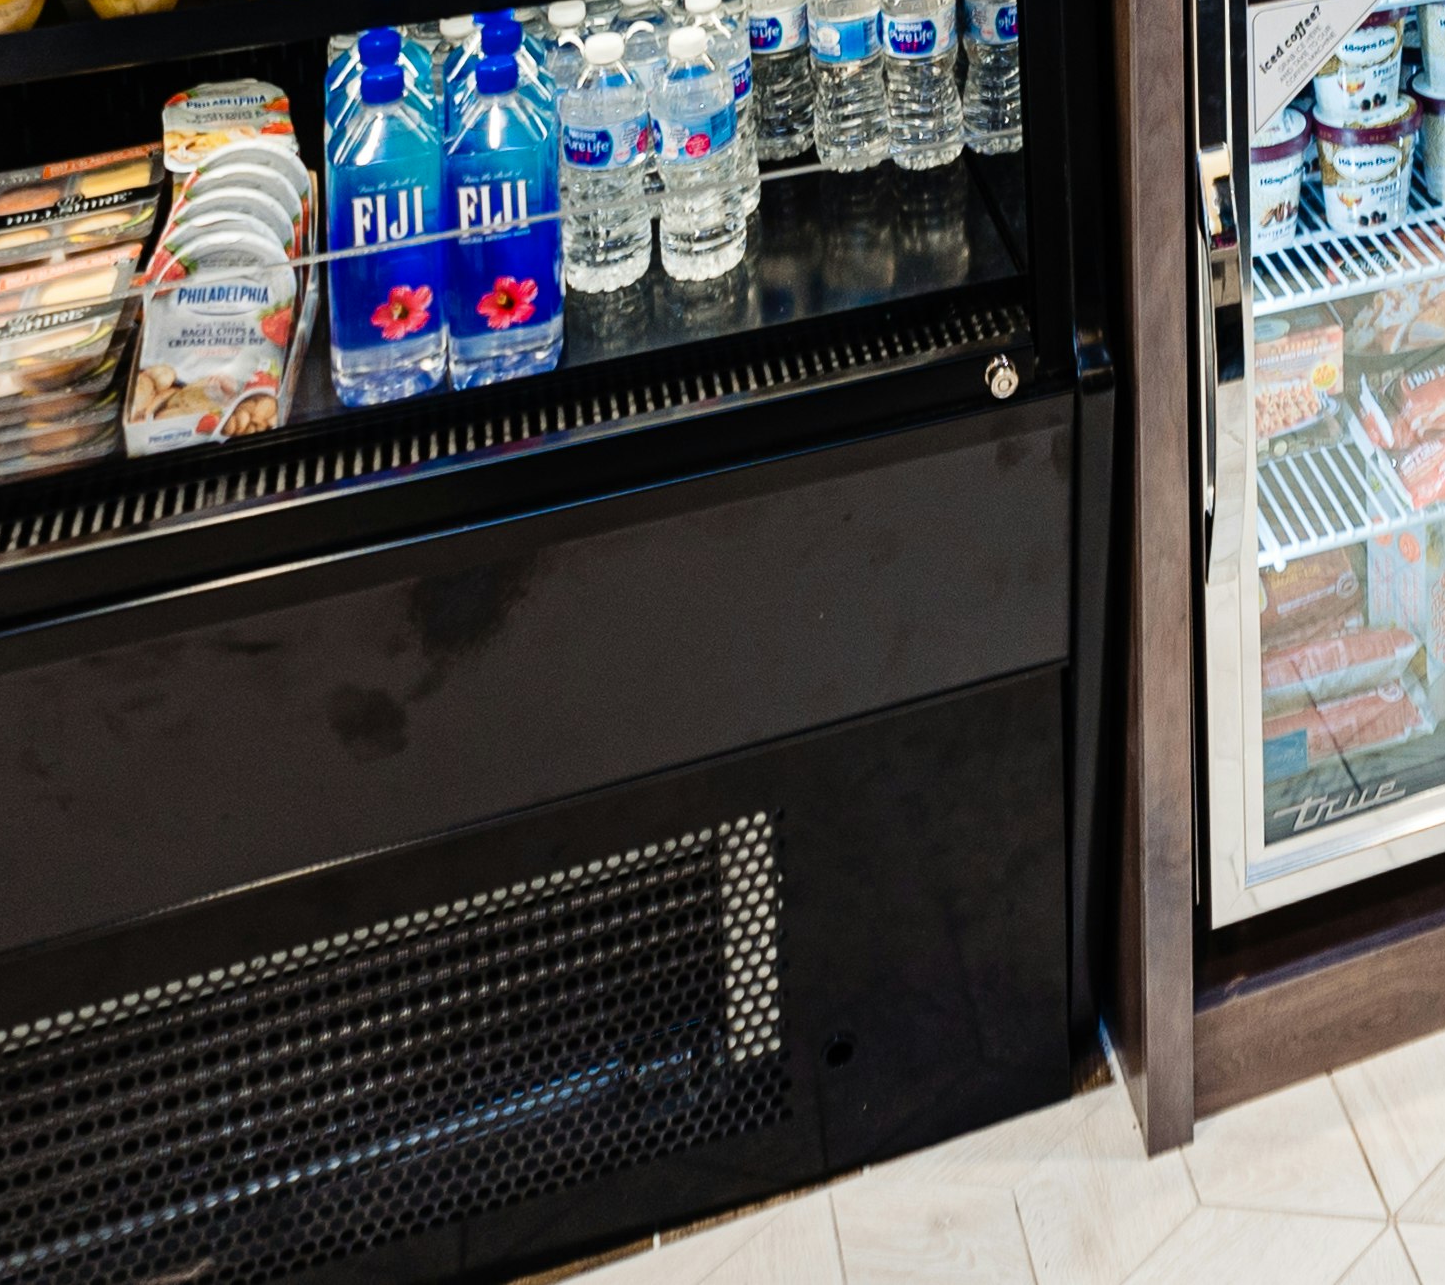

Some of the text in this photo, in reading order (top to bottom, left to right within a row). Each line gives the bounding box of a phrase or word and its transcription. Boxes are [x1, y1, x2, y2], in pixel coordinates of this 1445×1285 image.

[911, 27, 935, 44] Life
[1258, 3, 1321, 74] iced coffee?
[186, 94, 267, 109] PHILADELPHIA
[586, 137, 610, 154] Life
[351, 185, 425, 248] FIJI
[457, 178, 530, 239] FIJI
[176, 284, 270, 307] PHILADELPHIA
[168, 337, 205, 349] CREAM
[207, 335, 246, 347] CHEESE
[181, 327, 214, 339] BAGEL
[1273, 780, 1407, 831] true
